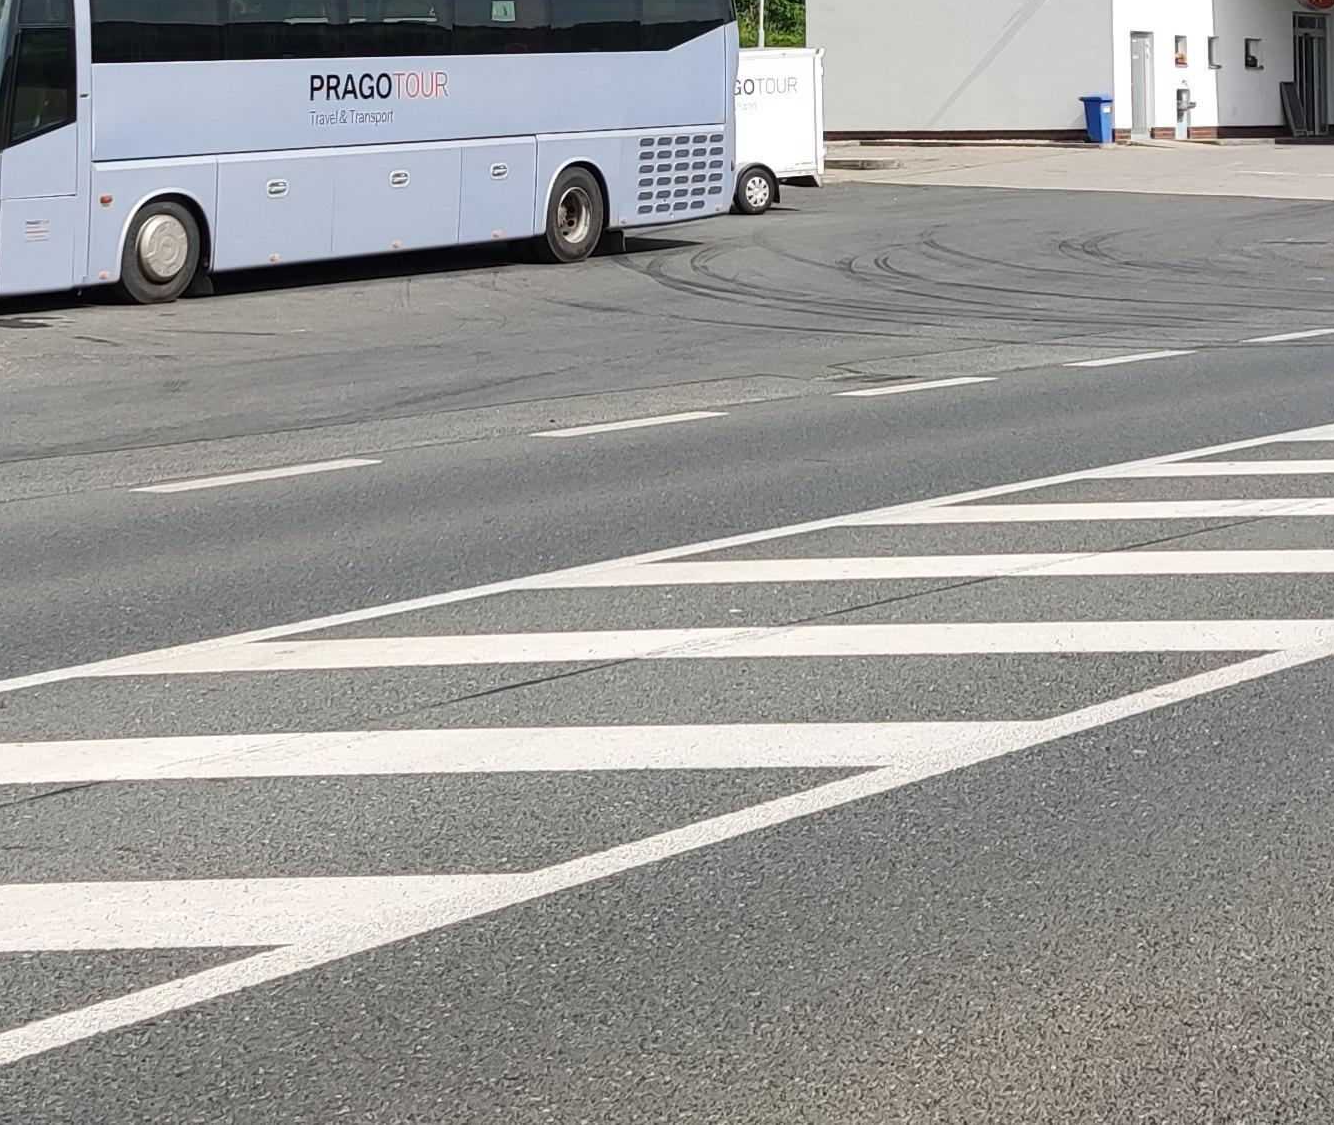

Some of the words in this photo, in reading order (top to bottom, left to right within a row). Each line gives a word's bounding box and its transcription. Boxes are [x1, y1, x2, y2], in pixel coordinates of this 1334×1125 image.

[309, 71, 450, 102] PRAGOTOUR
[309, 110, 338, 126] Travel
[339, 109, 348, 125] &
[350, 109, 394, 126] Transport
